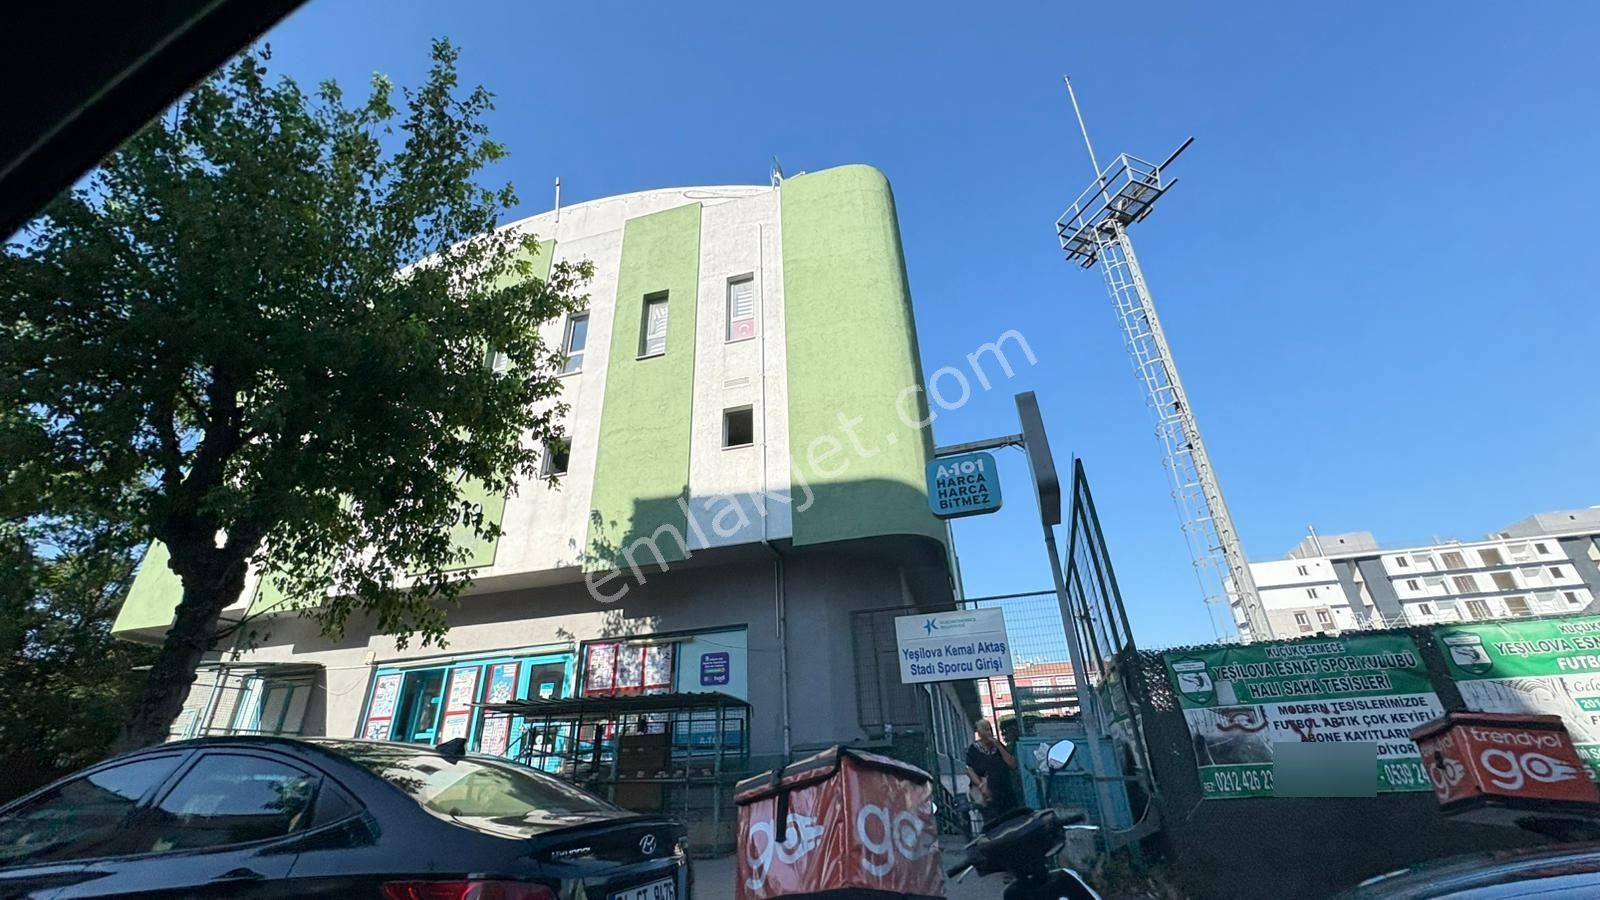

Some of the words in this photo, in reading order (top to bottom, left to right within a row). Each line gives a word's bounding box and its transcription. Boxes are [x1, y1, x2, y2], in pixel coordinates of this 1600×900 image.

[937, 473, 986, 489] HARCA
[938, 483, 988, 500] HARCA
[902, 647, 943, 662] Yeşilova
[944, 643, 975, 657] Kemal
[978, 641, 1006, 654] Aktaş
[1265, 642, 1345, 660] KÜÇÜKÇEKMECE
[1494, 638, 1573, 657] YEŞİLOVA
[910, 662, 935, 676] Stadı
[938, 660, 973, 676] Sporcu
[975, 656, 1003, 672] Girişi
[1212, 661, 1276, 682] YEŞİLOVA
[1276, 659, 1318, 676] ESNAF
[1321, 655, 1358, 673] SPOR
[1358, 649, 1417, 670] KULÜBÜ
[1557, 655, 1600, 670] FUTB
[1249, 682, 1283, 699] HALI
[1283, 679, 1323, 696] SAHA
[1322, 671, 1393, 693] TESİSLERİ
[1278, 703, 1330, 715] MODERN
[1330, 696, 1429, 714] TESİSLERİMİZDE
[1362, 714, 1389, 727] ÇOK
[1343, 728, 1413, 742] KAYITLARI
[1471, 728, 1562, 748] trendyol
[1377, 743, 1418, 756] DİYOR
[1481, 749, 1564, 789] go
[1214, 771, 1241, 792] 0212
[1242, 769, 1260, 791] 426
[857, 804, 925, 877] go
[743, 813, 815, 889] go
